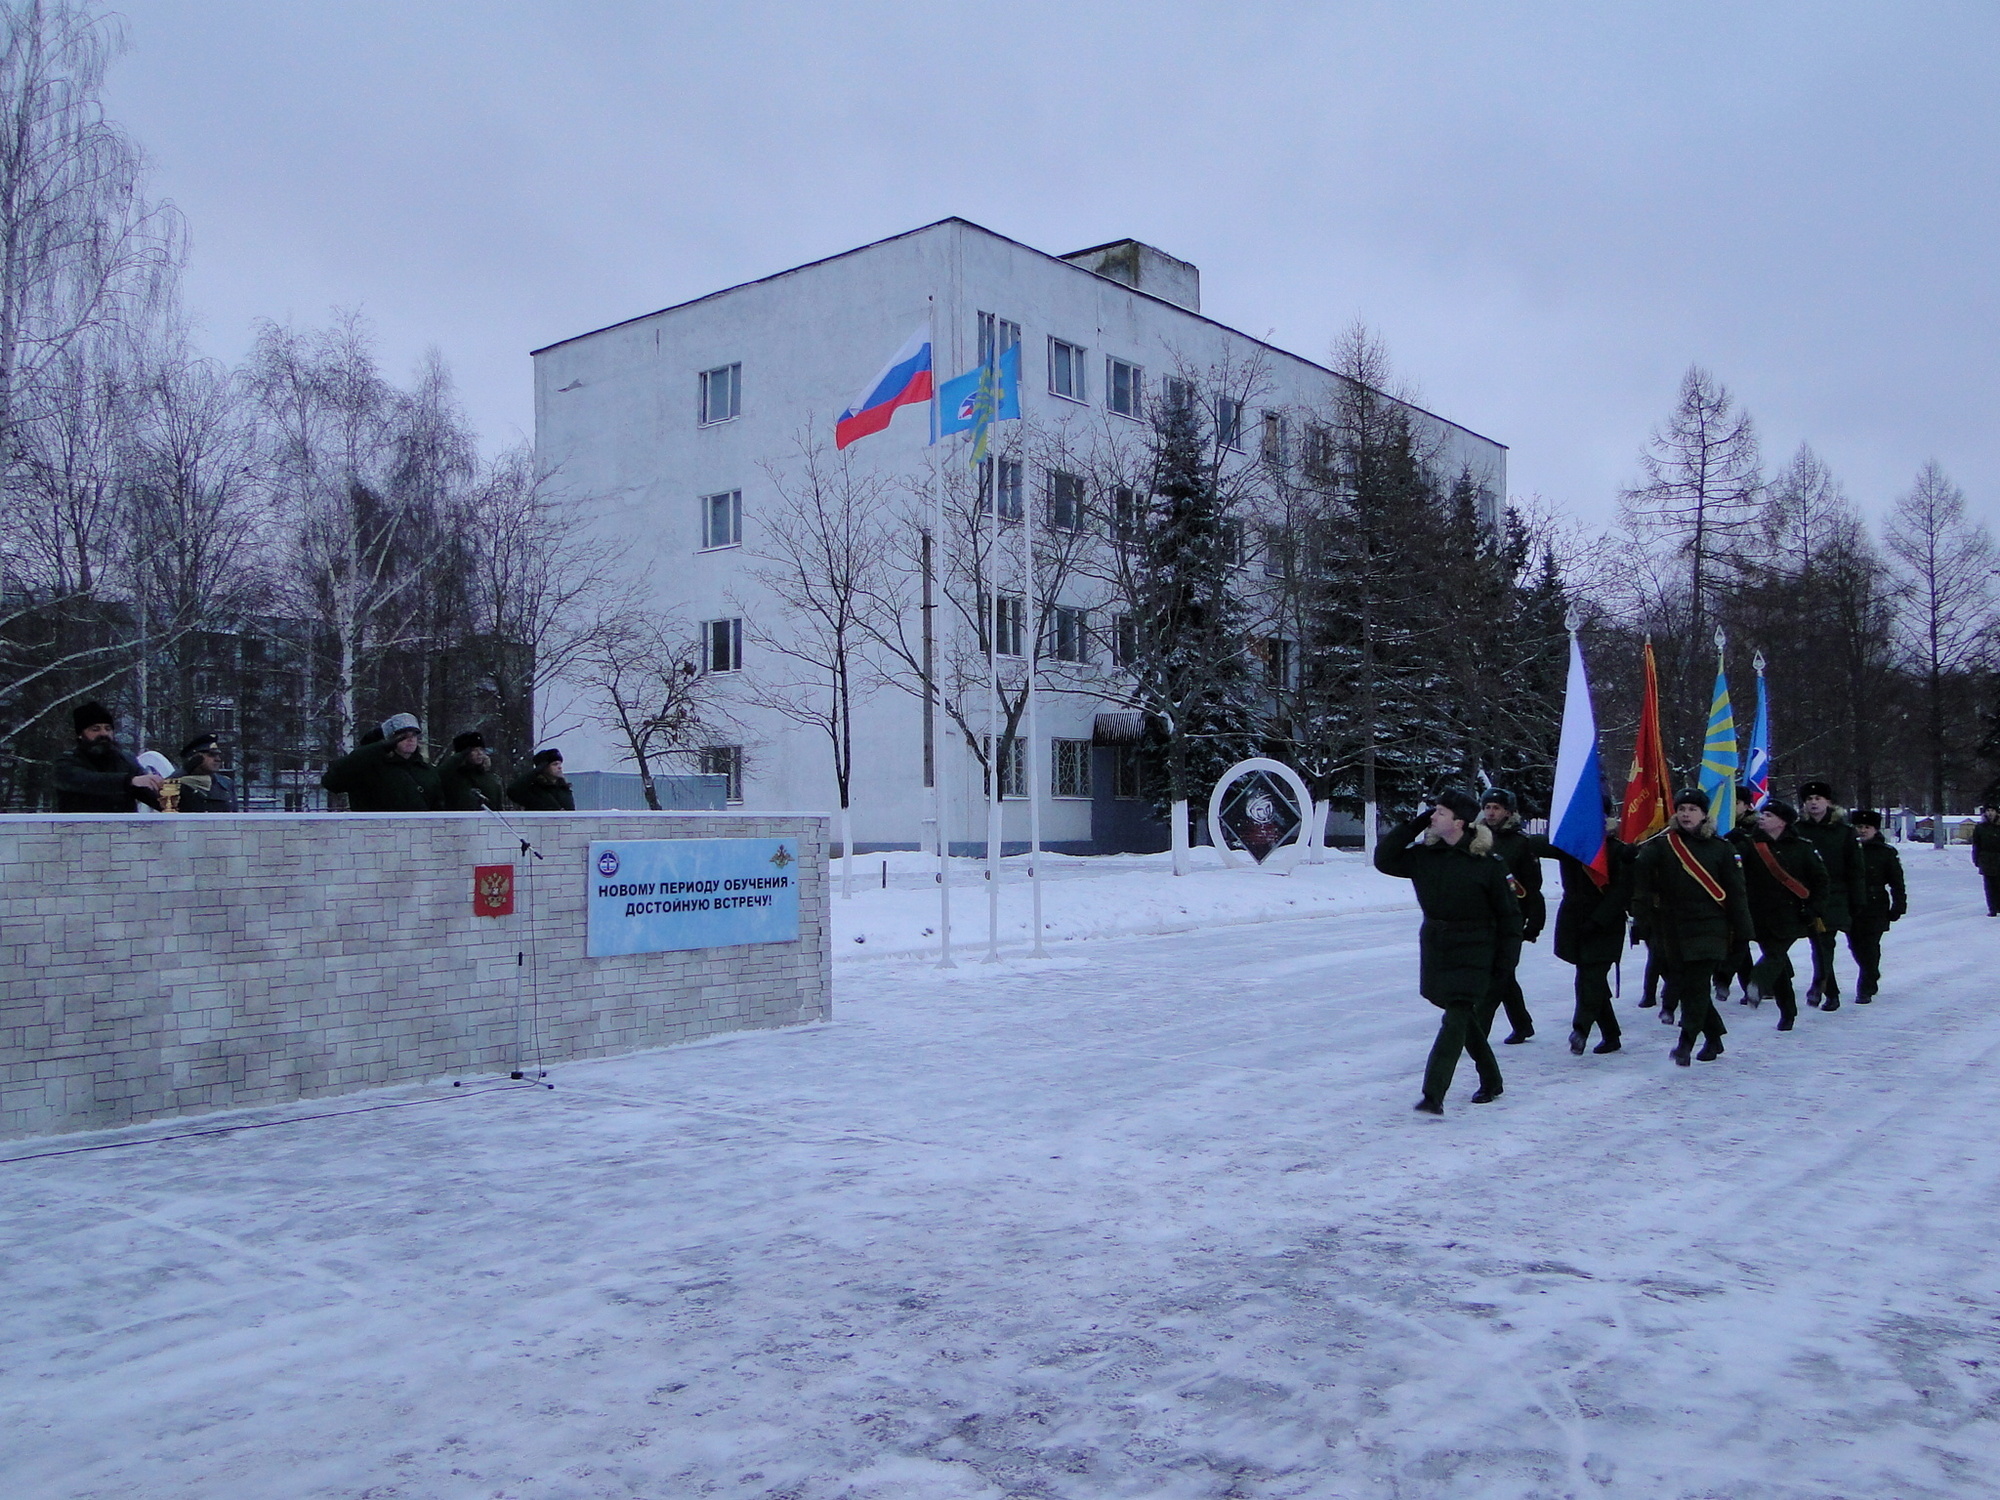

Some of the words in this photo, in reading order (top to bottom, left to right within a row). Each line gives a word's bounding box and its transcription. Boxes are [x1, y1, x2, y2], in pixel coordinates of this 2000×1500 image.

[598, 883, 656, 898] НОВОМУ
[660, 880, 720, 895] ПЕРИОДУ
[724, 876, 788, 891] ОБУЧЕНИЯ
[625, 898, 710, 917] ДОСТОЙНУЮ
[714, 895, 772, 910] ВСТРЕЧУ!
